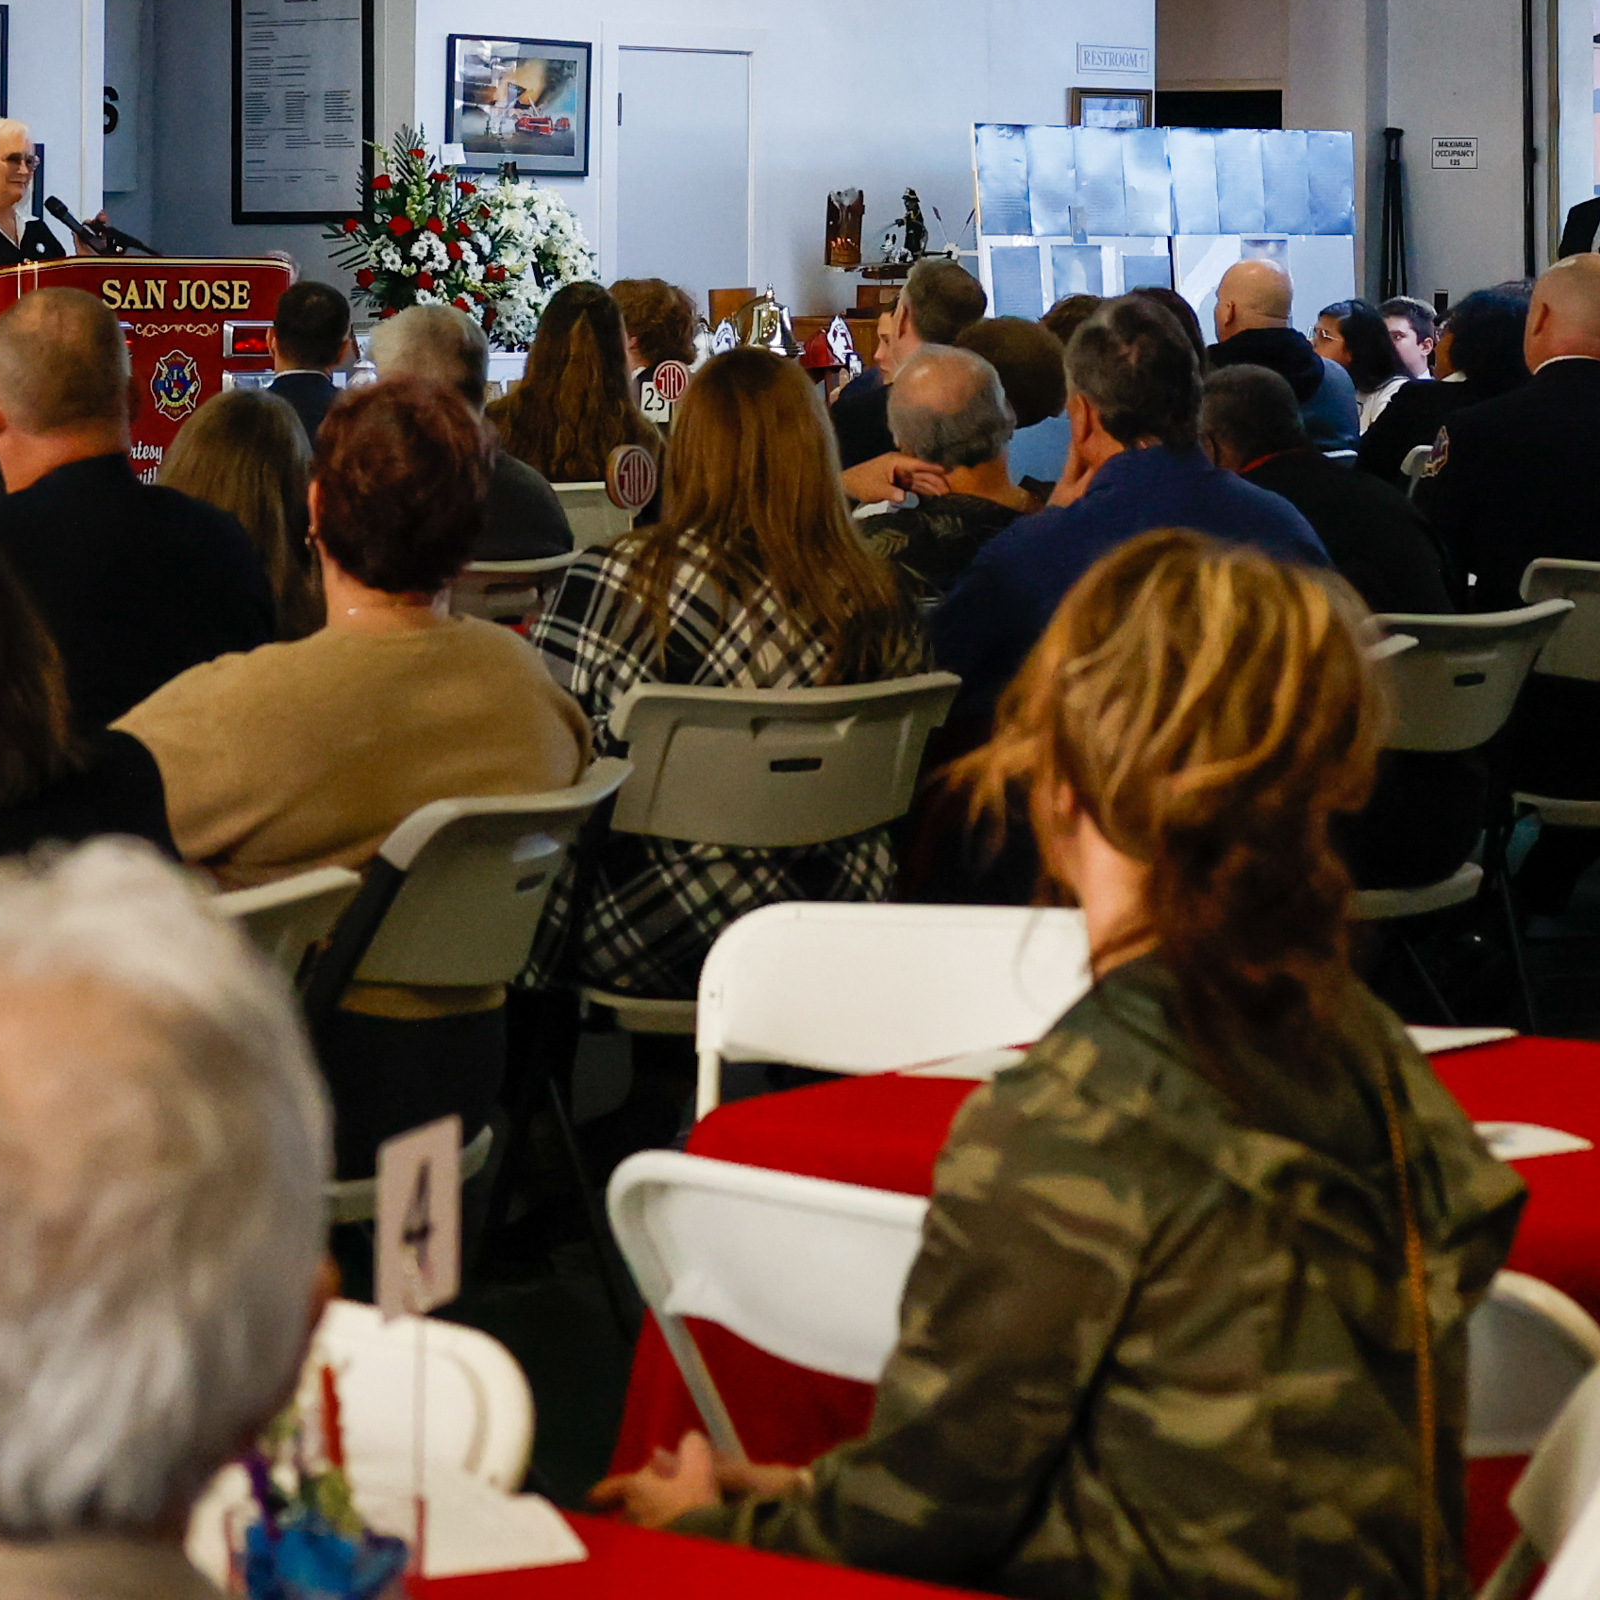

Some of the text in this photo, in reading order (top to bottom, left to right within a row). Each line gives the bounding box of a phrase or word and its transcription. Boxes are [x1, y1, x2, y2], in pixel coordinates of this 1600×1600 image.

[1084, 50, 1138, 68] RESTROOM
[101, 279, 251, 311] SAN JOSE
[128, 440, 163, 465] rtesy
[402, 1157, 434, 1278] 4
